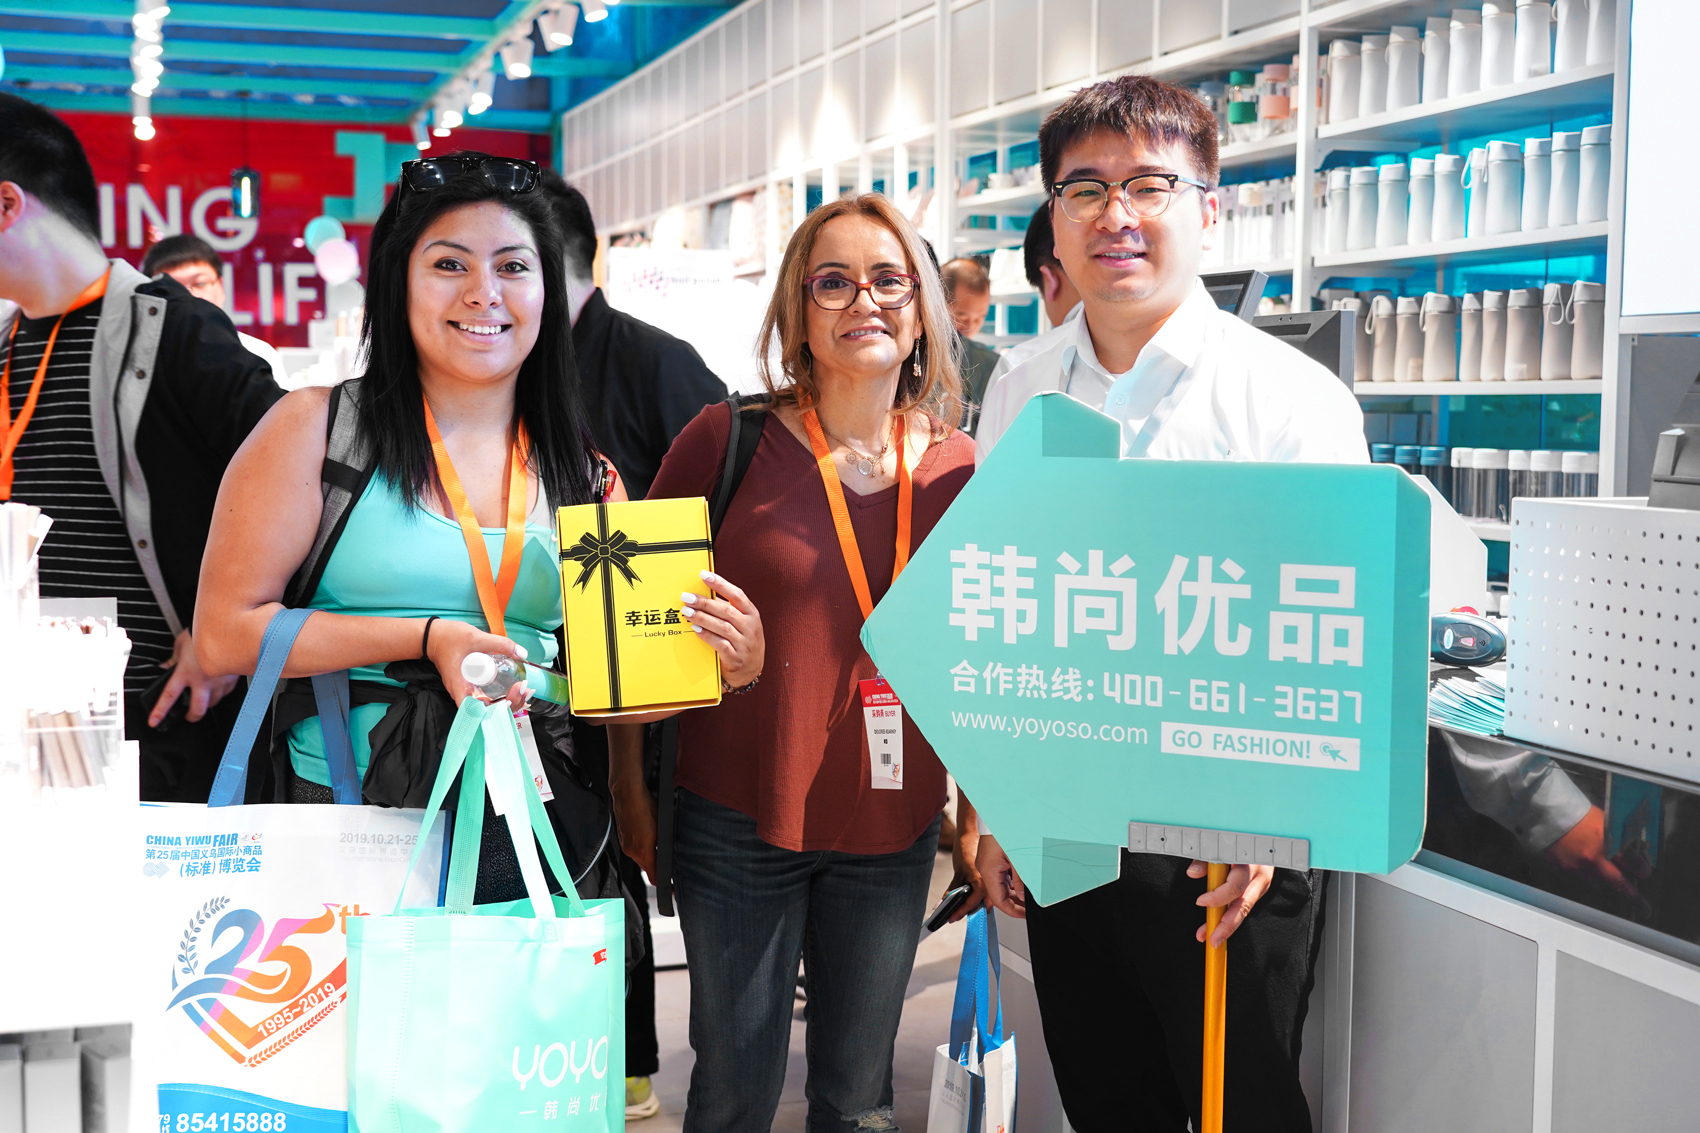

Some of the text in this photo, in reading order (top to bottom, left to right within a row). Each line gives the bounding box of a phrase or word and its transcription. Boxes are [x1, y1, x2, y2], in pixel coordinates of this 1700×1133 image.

[221, 262, 361, 326] LIF
[625, 608, 691, 627] 幸运盒
[949, 543, 1364, 667] 韩尚优品
[951, 711, 1148, 745] www.yoyoso.com
[1172, 729, 1311, 760] GO FASHION!
[146, 833, 239, 847] CHINA YIWU FAIR
[543, 1086, 608, 1121] 韩尚优
[176, 1112, 287, 1133] 85415888
